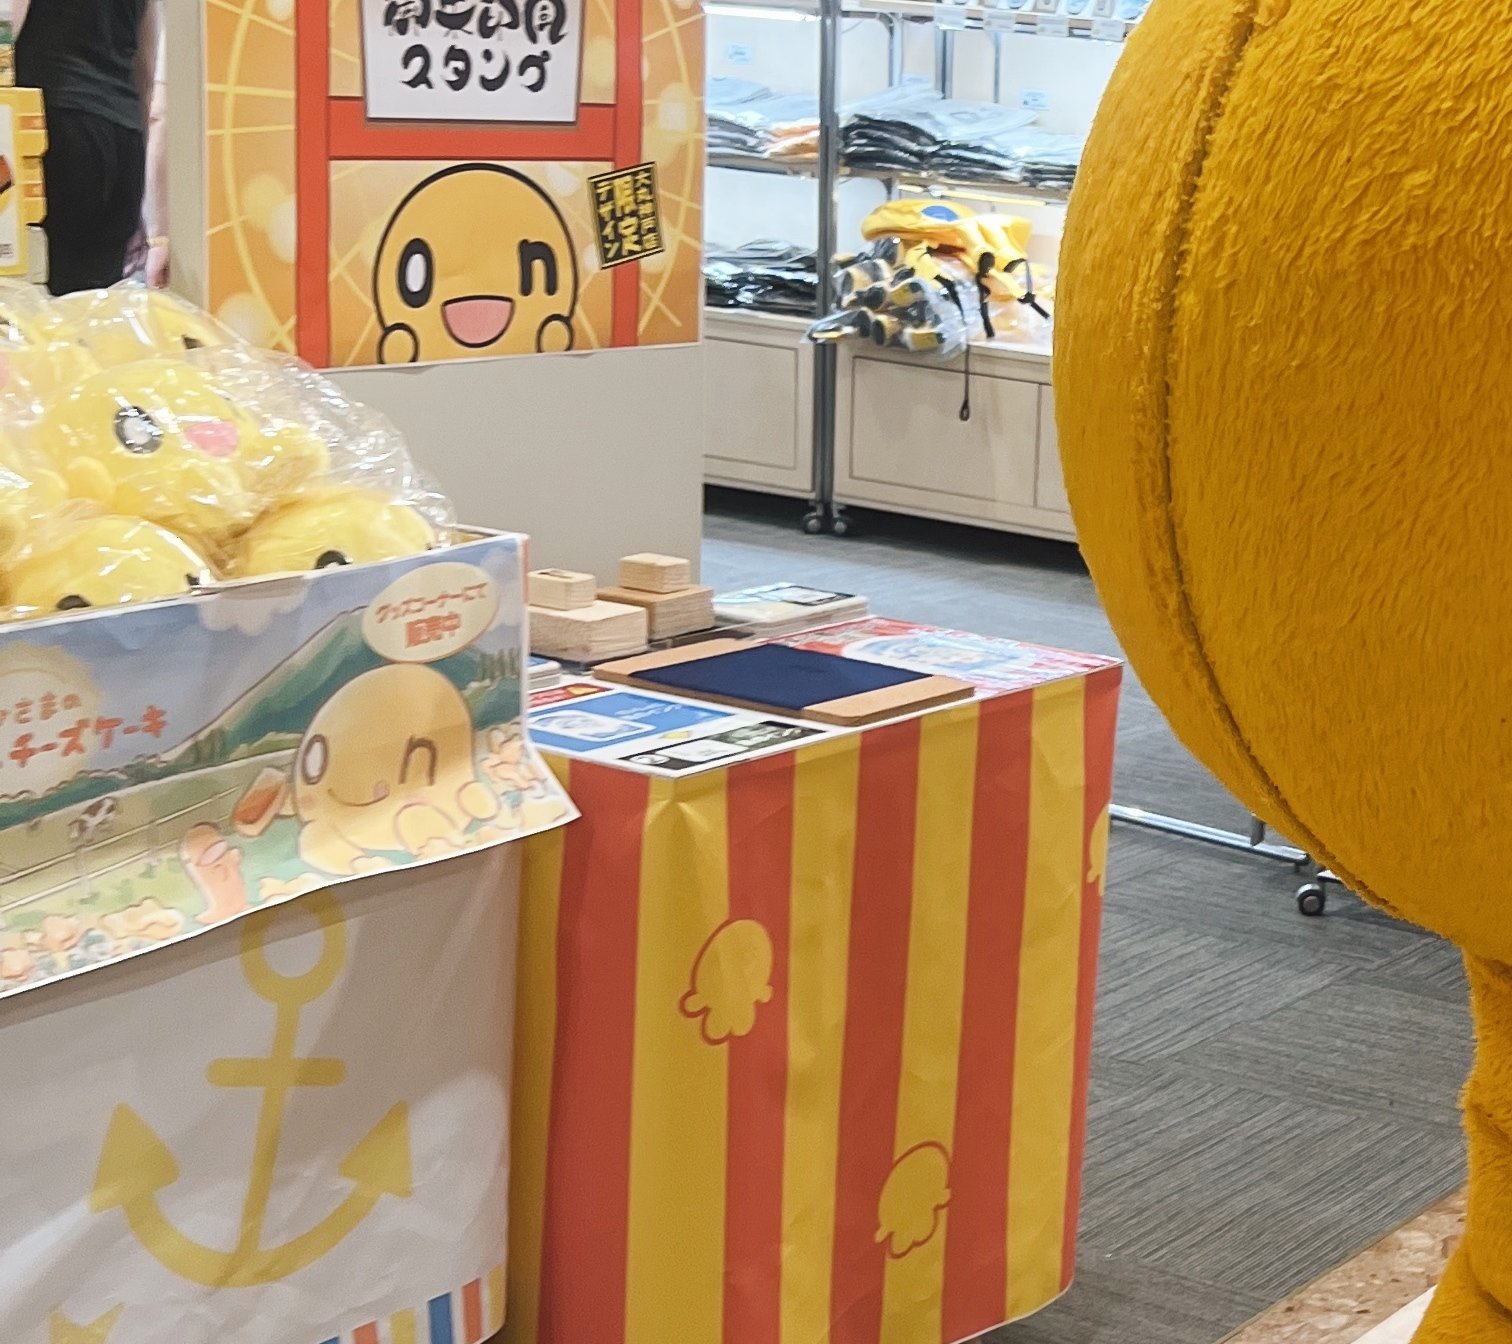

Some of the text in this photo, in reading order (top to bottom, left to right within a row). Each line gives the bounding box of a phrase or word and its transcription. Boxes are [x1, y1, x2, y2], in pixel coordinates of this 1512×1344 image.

[402, 44, 551, 93] スタンプ
[596, 181, 620, 259] デザイン
[613, 175, 642, 256] 限定
